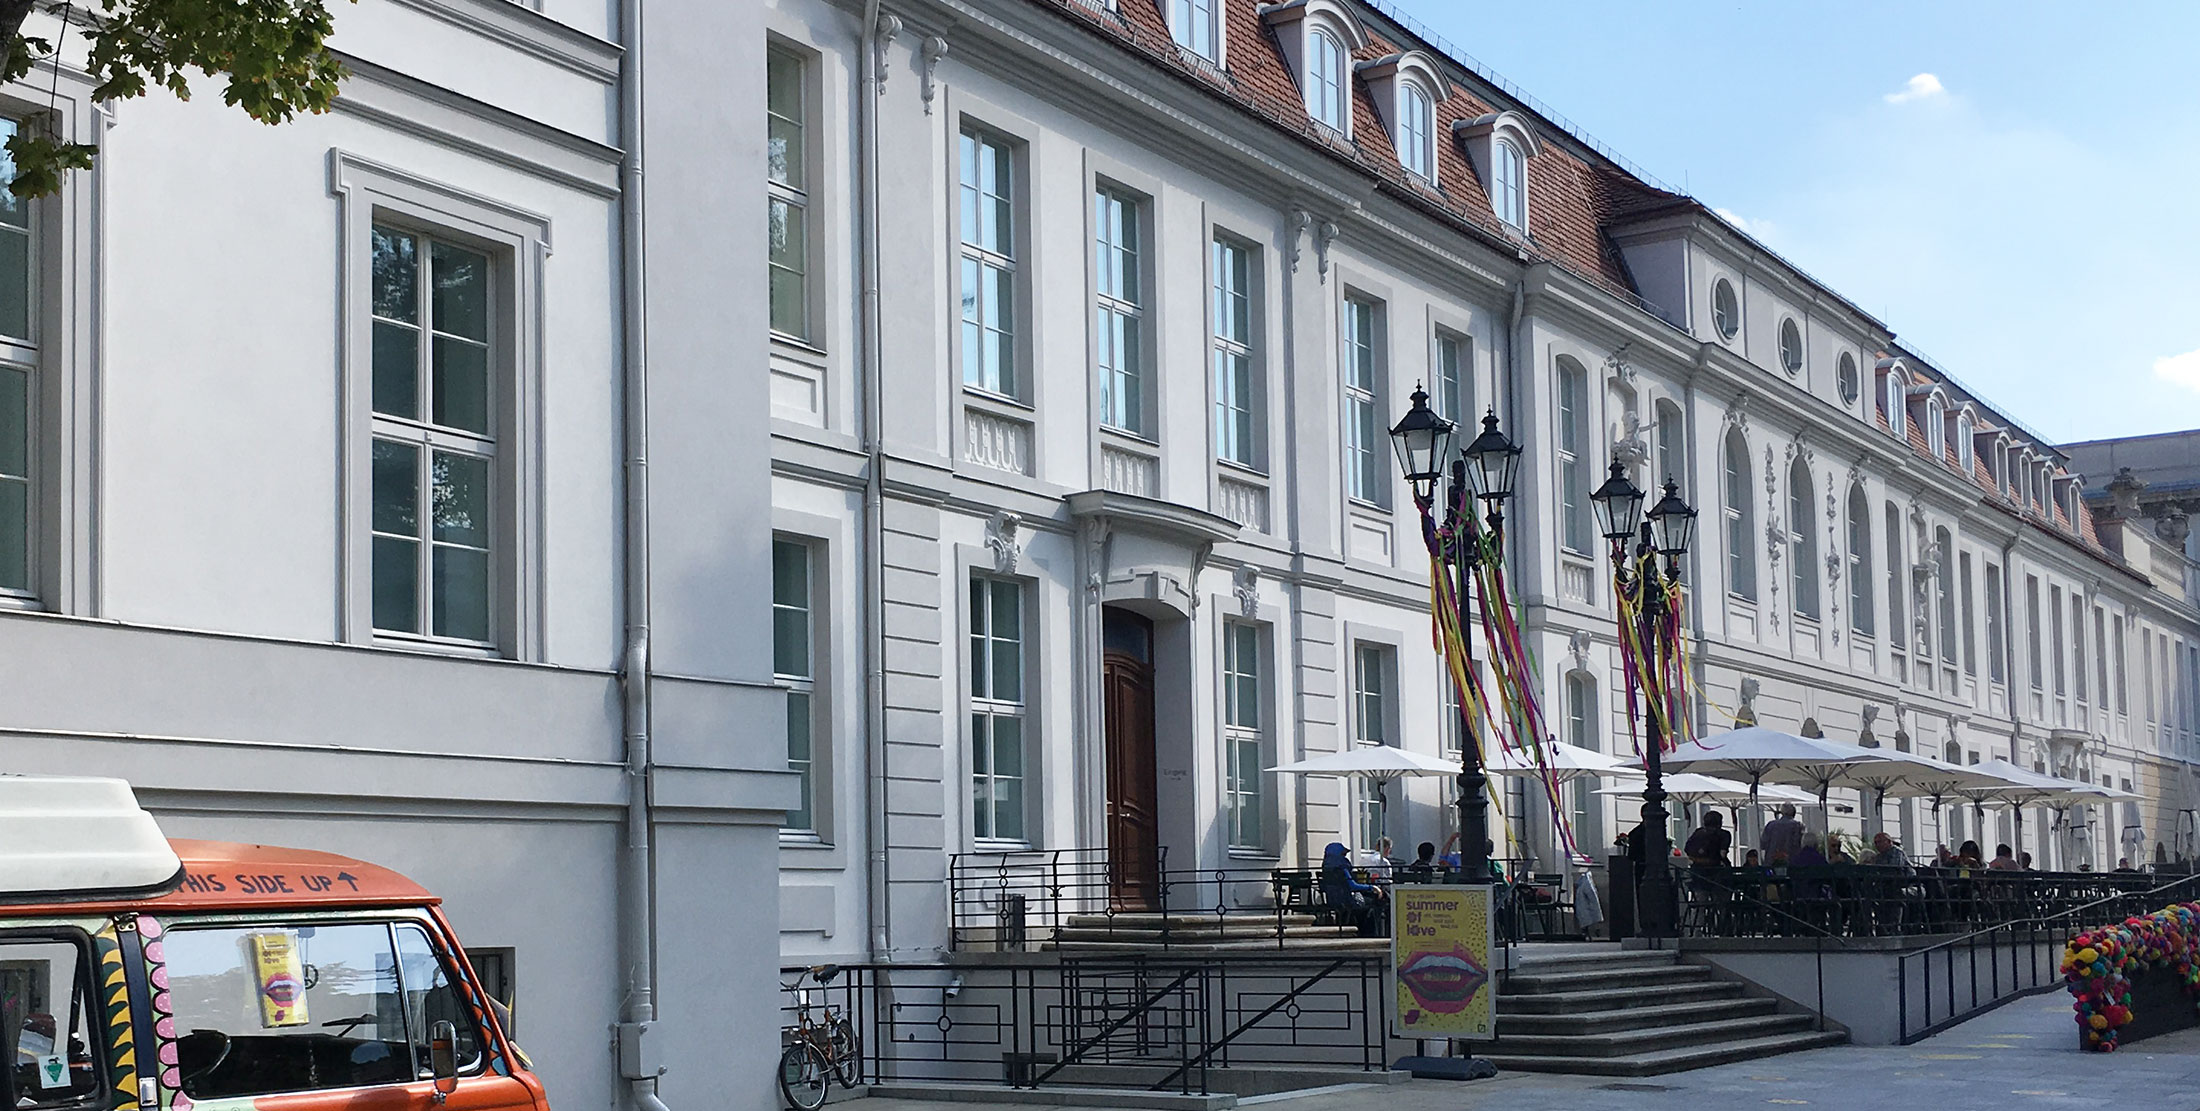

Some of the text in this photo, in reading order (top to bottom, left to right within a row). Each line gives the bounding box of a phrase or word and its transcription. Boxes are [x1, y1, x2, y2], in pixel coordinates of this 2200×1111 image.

[235, 874, 294, 894] SIDE
[301, 874, 333, 893] UP
[1406, 900, 1459, 911] summer
[1406, 911, 1422, 923] of
[1406, 924, 1436, 936] love
